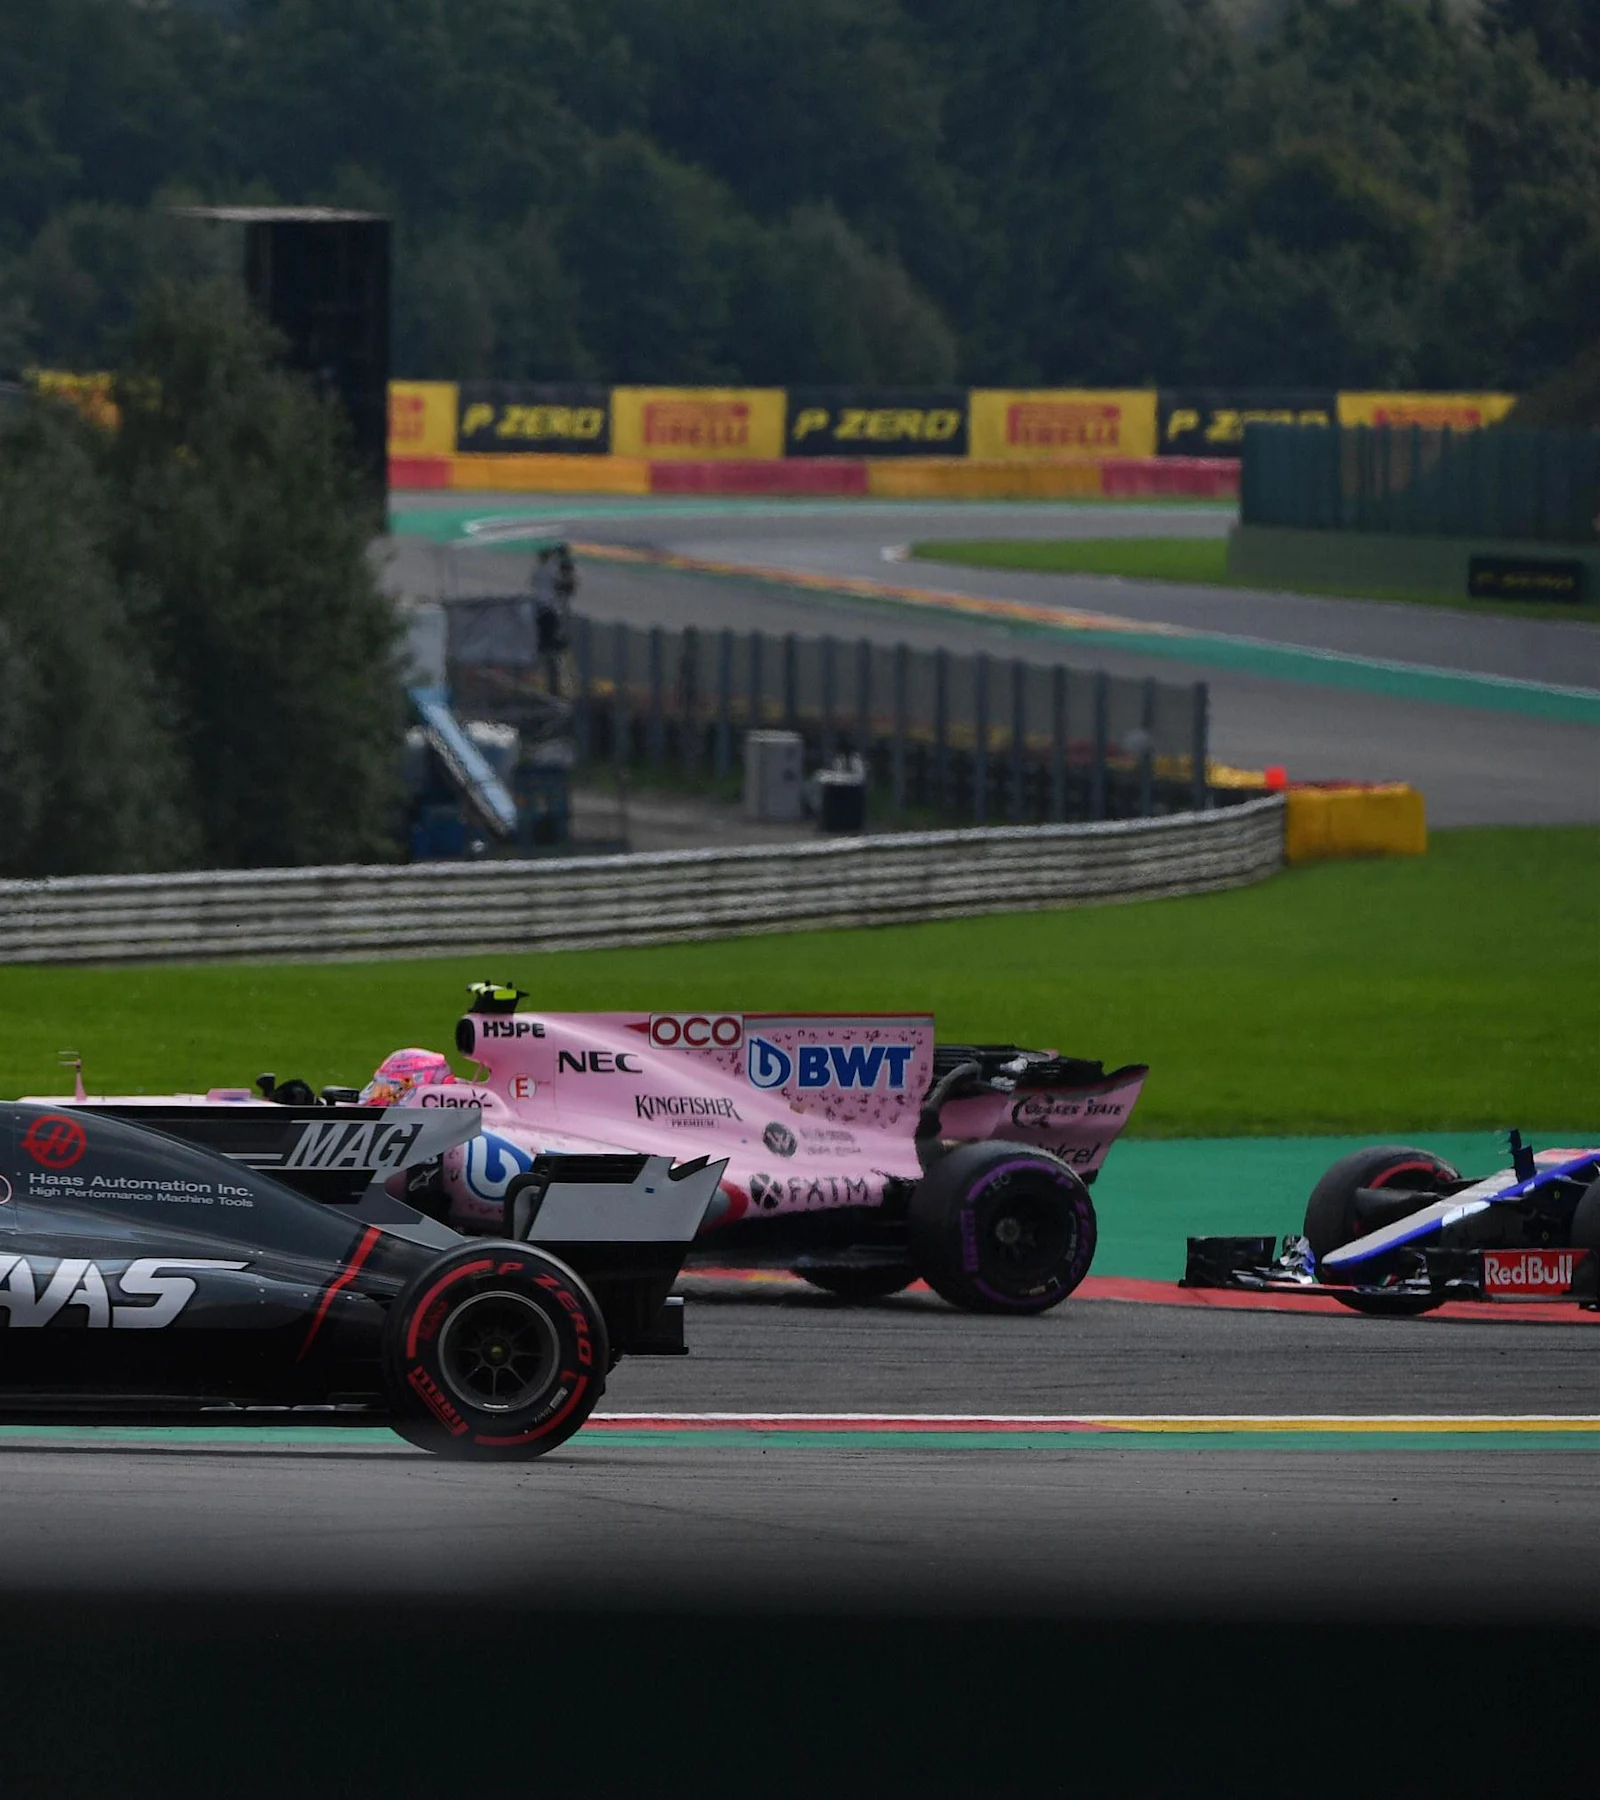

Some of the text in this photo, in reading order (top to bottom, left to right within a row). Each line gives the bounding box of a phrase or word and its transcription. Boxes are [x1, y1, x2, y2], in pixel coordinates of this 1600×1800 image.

[462, 403, 495, 436] P
[496, 405, 603, 440] ZERO
[794, 409, 960, 441] P ZERO
[483, 1021, 545, 1038] HYPE
[558, 1050, 642, 1074] NEC
[799, 1045, 913, 1088] BWT
[515, 1077, 529, 1098] E
[634, 1095, 744, 1121] KINGFISHER
[671, 1119, 715, 1128] PREMIUM
[289, 1123, 414, 1168] MAG
[29, 1172, 254, 1197] Haas Automation Inc.
[29, 1186, 254, 1208] High Performance Machine Tools
[496, 1262, 592, 1366] P ZERO
